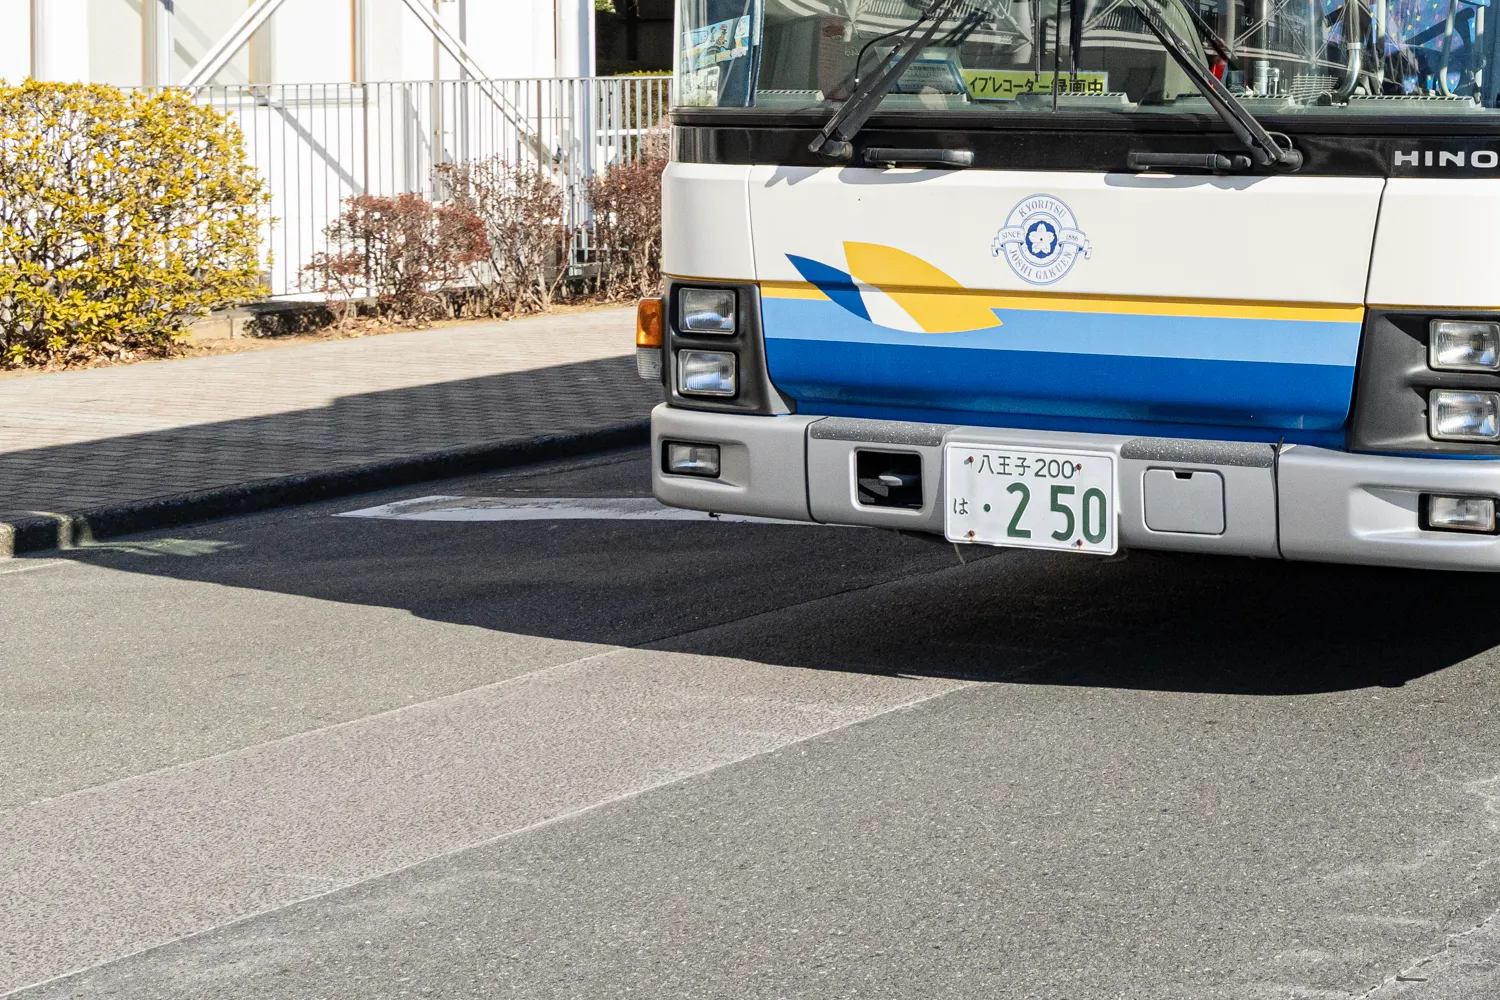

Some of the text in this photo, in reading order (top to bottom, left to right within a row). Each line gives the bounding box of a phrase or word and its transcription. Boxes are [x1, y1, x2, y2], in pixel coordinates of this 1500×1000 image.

[1393, 150, 1499, 169] HINO
[1018, 199, 1067, 219] KYORITSU
[1001, 231, 1021, 240] SINCE
[1009, 249, 1073, 280] JOSHI GAKUEN
[953, 498, 969, 515] は
